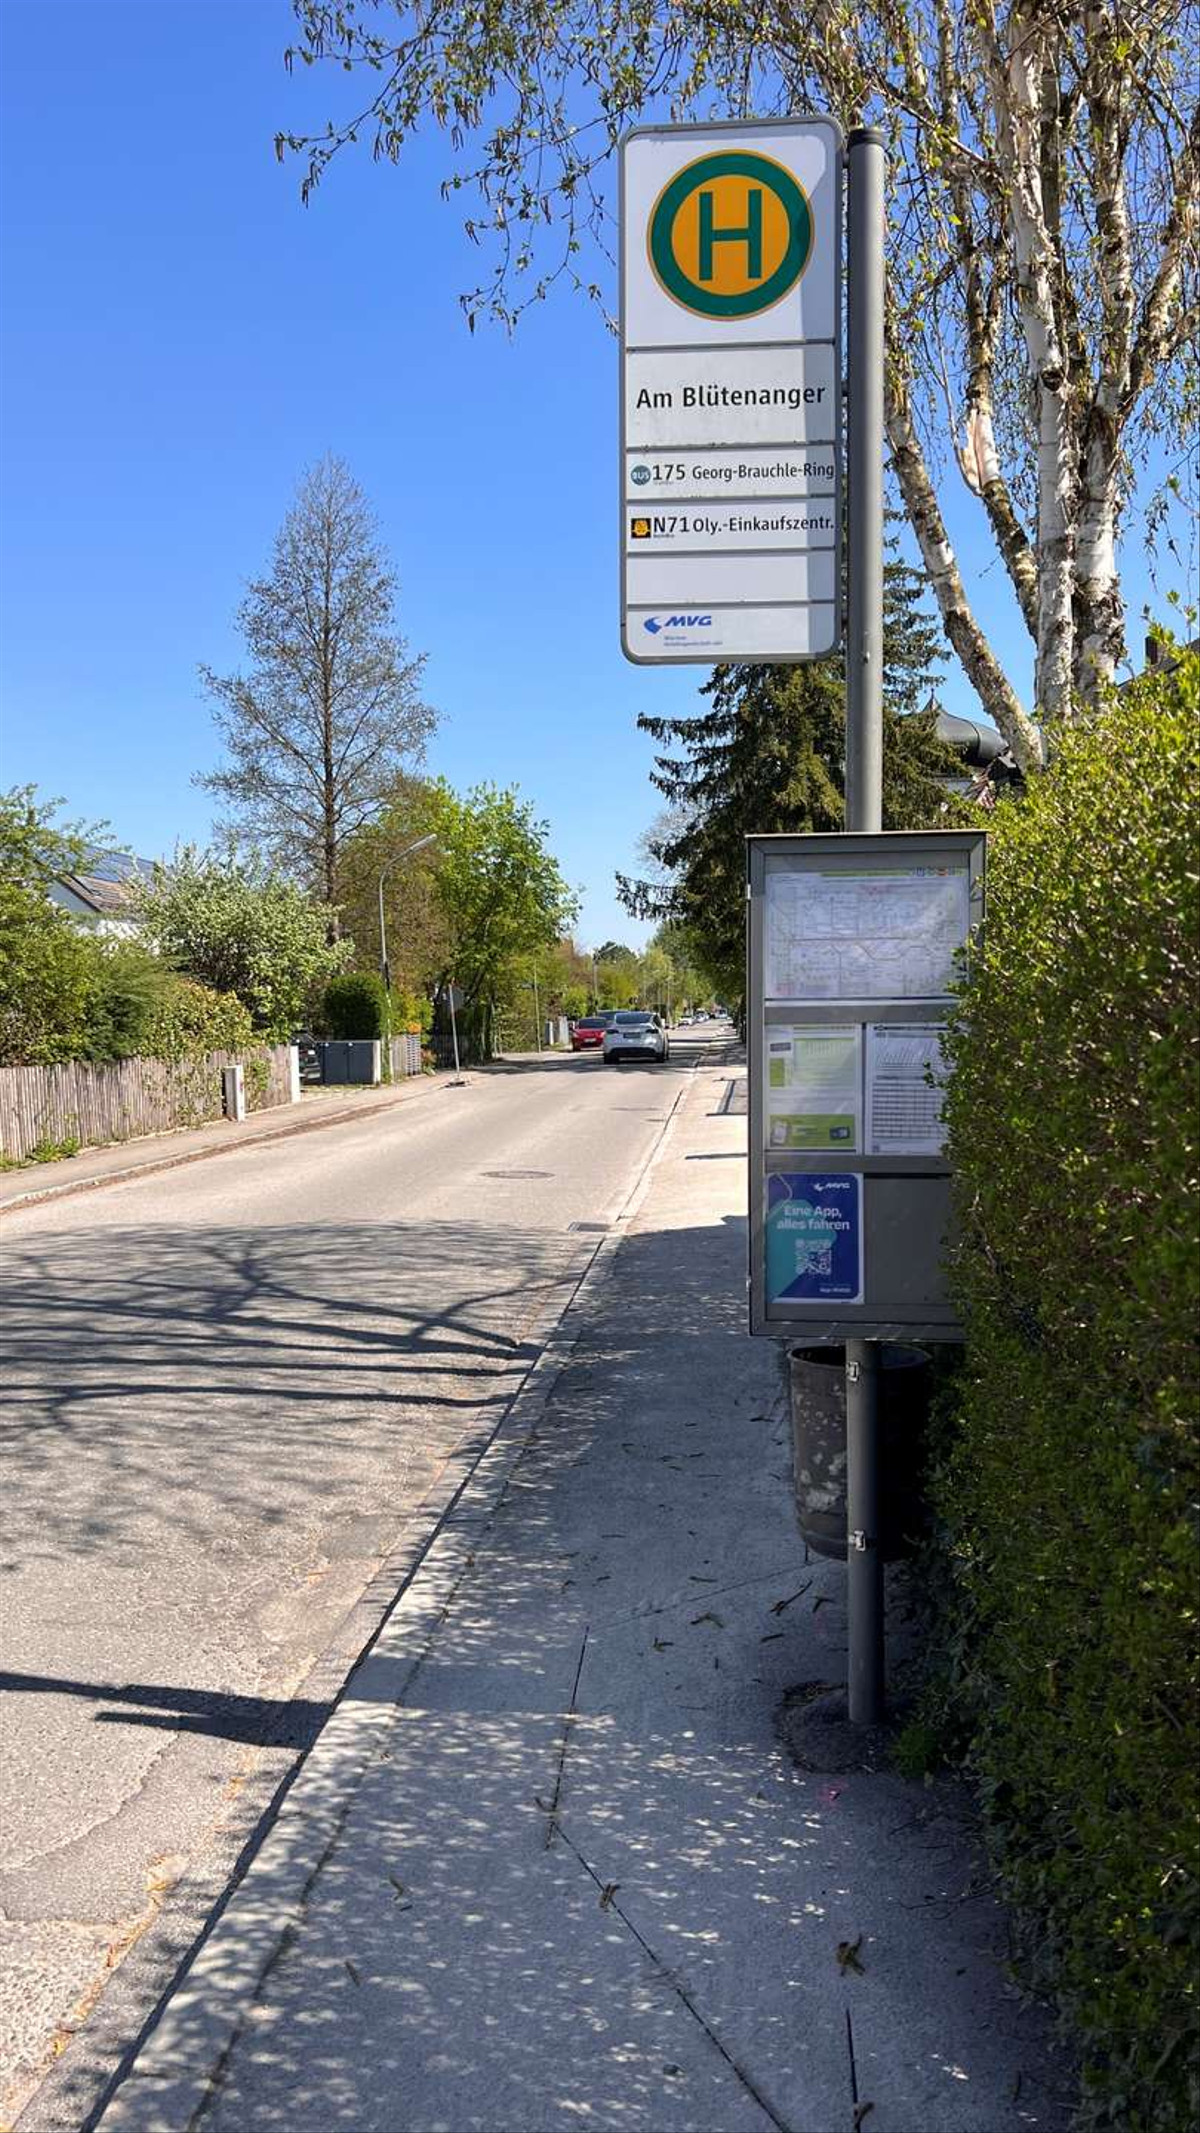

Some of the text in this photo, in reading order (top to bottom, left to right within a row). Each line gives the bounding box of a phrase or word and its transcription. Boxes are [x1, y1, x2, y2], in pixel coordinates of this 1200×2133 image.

[699, 189, 762, 281] H
[636, 384, 826, 409] Am Blütenanger
[652, 462, 835, 482] 175 Georg-Brauchle-Ring
[653, 516, 835, 535] N71 Oly.-Einkaufszentr.
[664, 615, 712, 627] MVG
[783, 1205, 842, 1219] Eine App,
[776, 1218, 850, 1231] alles fahren
